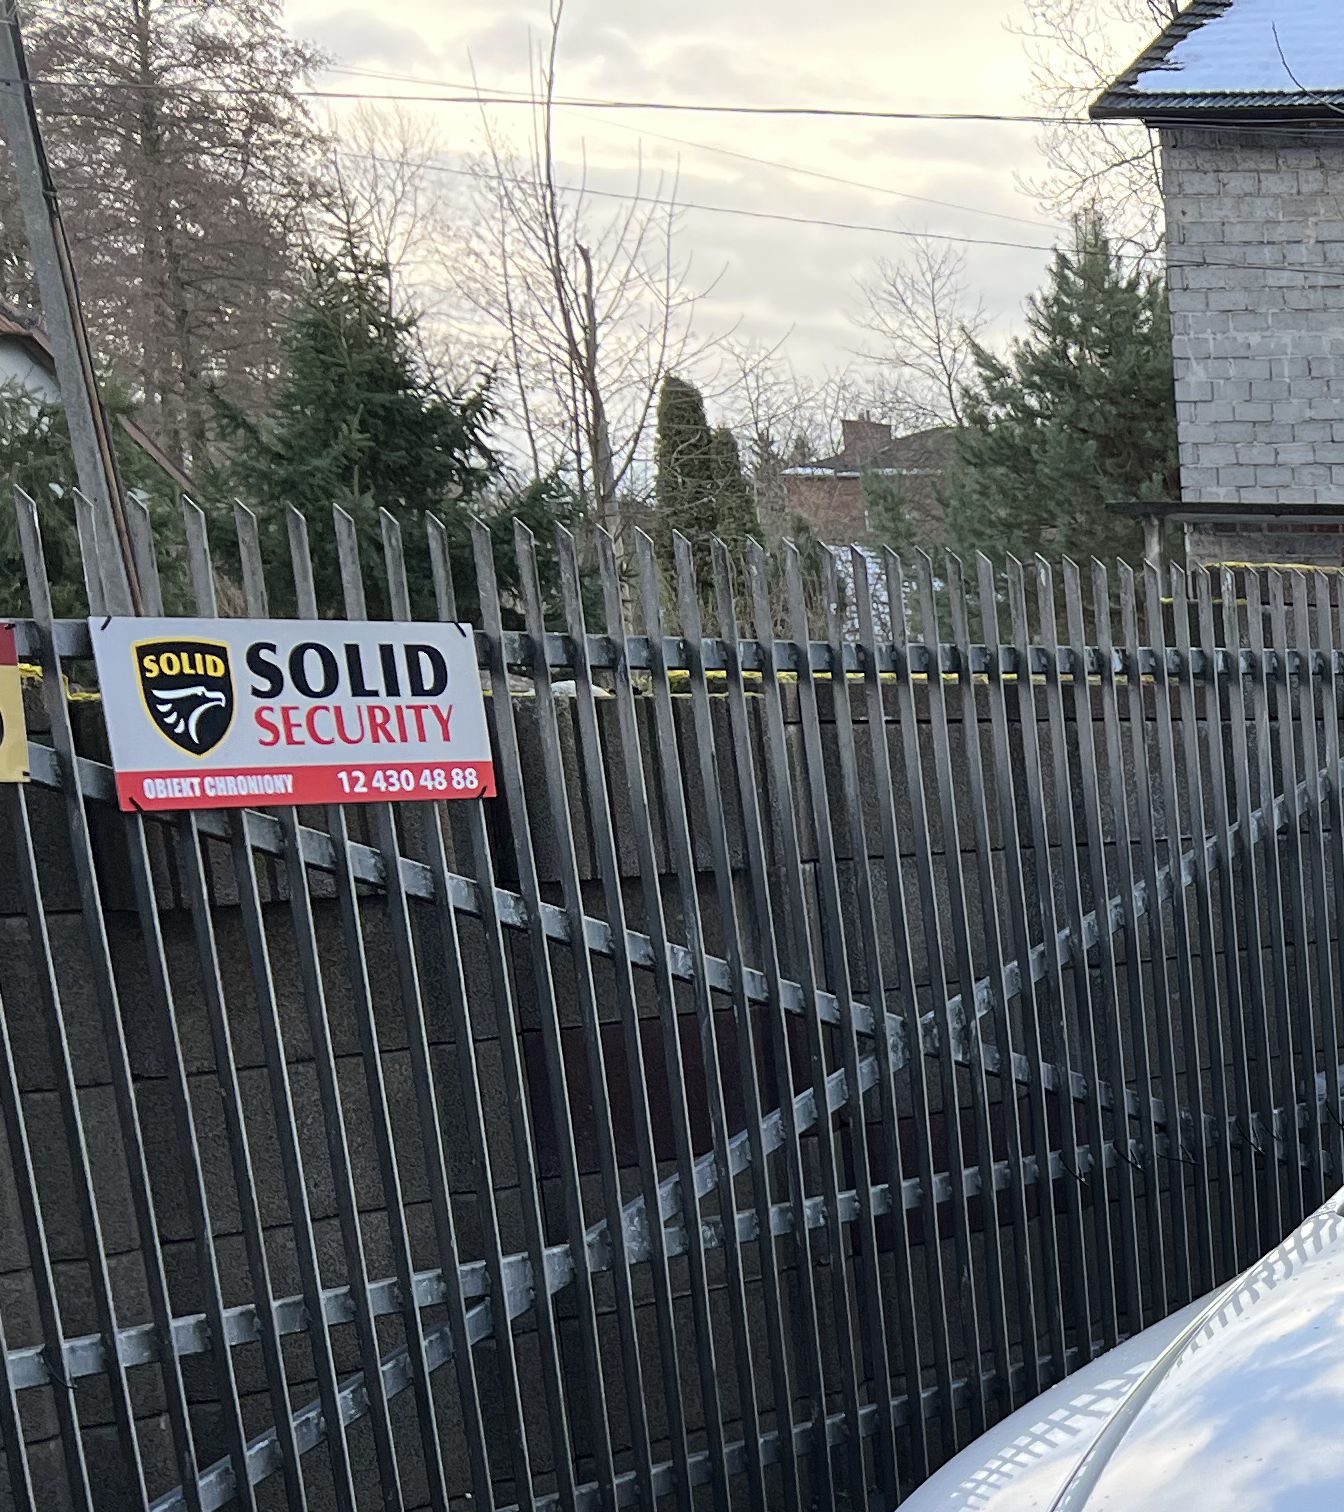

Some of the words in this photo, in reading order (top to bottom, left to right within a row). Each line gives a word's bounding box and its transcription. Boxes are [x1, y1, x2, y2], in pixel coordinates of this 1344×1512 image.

[142, 652, 226, 679] SOLID
[246, 641, 448, 699] SOLID
[253, 704, 454, 747] SECURITY
[143, 777, 201, 799] OBIEKT
[204, 774, 293, 797] CHRONIONY
[337, 770, 368, 793] 12
[372, 769, 415, 792] 430
[419, 768, 448, 790] 48
[451, 767, 479, 790] 88
